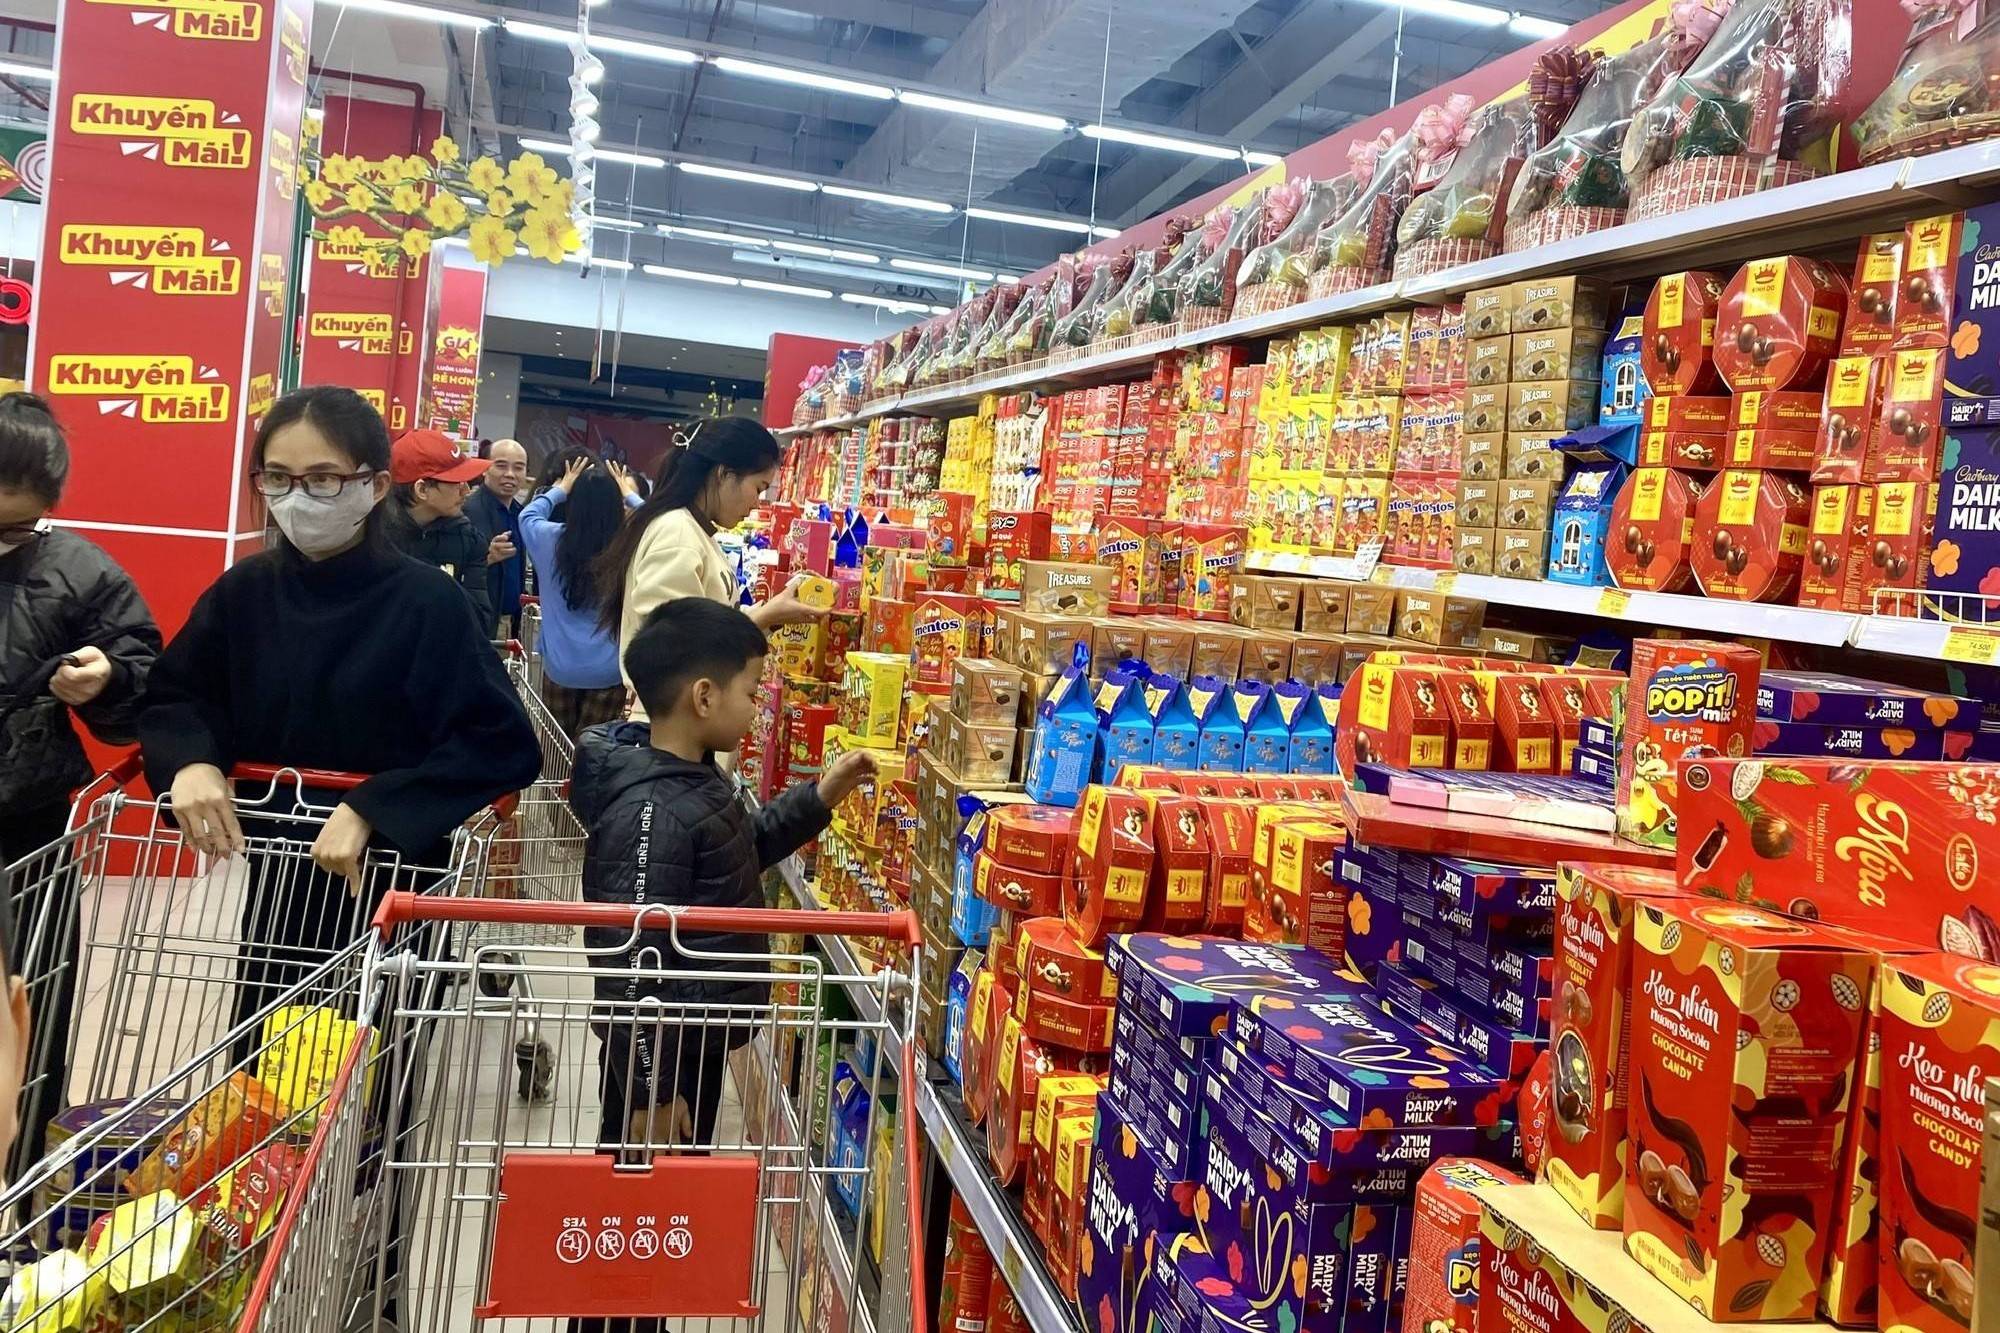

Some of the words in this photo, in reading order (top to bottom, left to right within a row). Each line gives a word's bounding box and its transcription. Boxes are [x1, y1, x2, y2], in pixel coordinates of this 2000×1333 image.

[182, 5, 257, 38] Mãi!
[77, 102, 207, 131] Khuyến
[171, 132, 247, 165] Mãi!
[67, 232, 197, 260] Khuyến
[160, 259, 236, 292] Mãi!
[1525, 286, 1558, 305] TREASURES
[315, 316, 388, 334] Khuyến
[1525, 338, 1555, 356] TREASURES
[55, 360, 185, 390] Khuyến
[149, 386, 225, 419] Mãi!
[1520, 389, 1552, 405] TREASURES
[1950, 413, 1970, 422] MILK
[1951, 403, 1975, 415] DAIRY
[1770, 449, 1797, 457] CHOCOLATE
[1954, 464, 1999, 486] Cadbury
[1508, 487, 1535, 503] TREASURES
[1047, 570, 1091, 588] TREASURES
[914, 619, 960, 637] mentos
[1494, 637, 1520, 652] TREASURES
[1647, 686, 1705, 714] POP
[1882, 700, 1904, 710] MILK
[1702, 706, 1731, 723] mix
[1876, 709, 1904, 719] DAIRY
[1835, 739, 1863, 748] DAIRY
[1841, 730, 1863, 739] MILK
[640, 801, 653, 832] FENDI
[637, 836, 649, 868] FENDI
[1834, 792, 1914, 908] Mira
[1445, 869, 1462, 886] MILK
[635, 873, 646, 904] FENDI
[1440, 882, 1461, 898] DAIRY
[1447, 910, 1472, 929] DAIRY
[1580, 911, 1605, 953] nhân
[1504, 950, 1523, 967] MILK
[1565, 954, 1593, 981] CHOCOLATE
[1499, 963, 1523, 980] DAIRY
[1506, 989, 1524, 1006] MILK
[1643, 968, 1684, 1022] Kẹo
[1680, 984, 1720, 1035] nhân
[1500, 1002, 1523, 1018] DAIRY
[1236, 1014, 1254, 1030] DAIRY
[1471, 1024, 1489, 1041] MILK
[1650, 1007, 1679, 1037] Hương
[1236, 1024, 1251, 1043] MILK
[637, 1038, 652, 1068] FENDI
[1467, 1036, 1489, 1055] DAIRY
[1652, 1032, 1704, 1072] CHOCOLATE
[1662, 1056, 1692, 1081] CANDY
[1898, 1041, 1957, 1103] Kẹo
[1405, 1099, 1443, 1112] DAIRY
[1909, 1082, 1950, 1119] Hương
[1305, 1114, 1320, 1136] MILK
[1404, 1112, 1434, 1124] MILK
[1300, 1125, 1320, 1150] DAIRY
[1401, 1135, 1431, 1147] MILK
[1913, 1112, 1981, 1155] CHOCOLAT
[1283, 1145, 1298, 1166] MILK
[1391, 1147, 1430, 1158] DAIRY
[1929, 1139, 1973, 1169] CANDY
[1208, 1140, 1243, 1190] DAIRY
[1279, 1155, 1297, 1180] DAIRY
[1378, 1169, 1406, 1179] MILK
[1206, 1163, 1232, 1210] MILK
[1367, 1178, 1406, 1191] DAIRY
[1092, 1167, 1126, 1228] DAIRY
[562, 1216, 588, 1228] YES
[601, 1216, 621, 1227] NO
[636, 1215, 656, 1226] NO
[669, 1215, 689, 1226] NO
[1090, 1195, 1115, 1254] MILK
[1311, 1255, 1325, 1289] MILK
[1321, 1254, 1336, 1297] DAIRY
[1353, 1254, 1368, 1288] MILK
[1364, 1253, 1378, 1296] DAIRY
[1394, 1258, 1409, 1292] MILK
[1490, 1249, 1526, 1303] Kẹo
[1523, 1270, 1560, 1321] nhân
[1496, 1284, 1522, 1314] Hương
